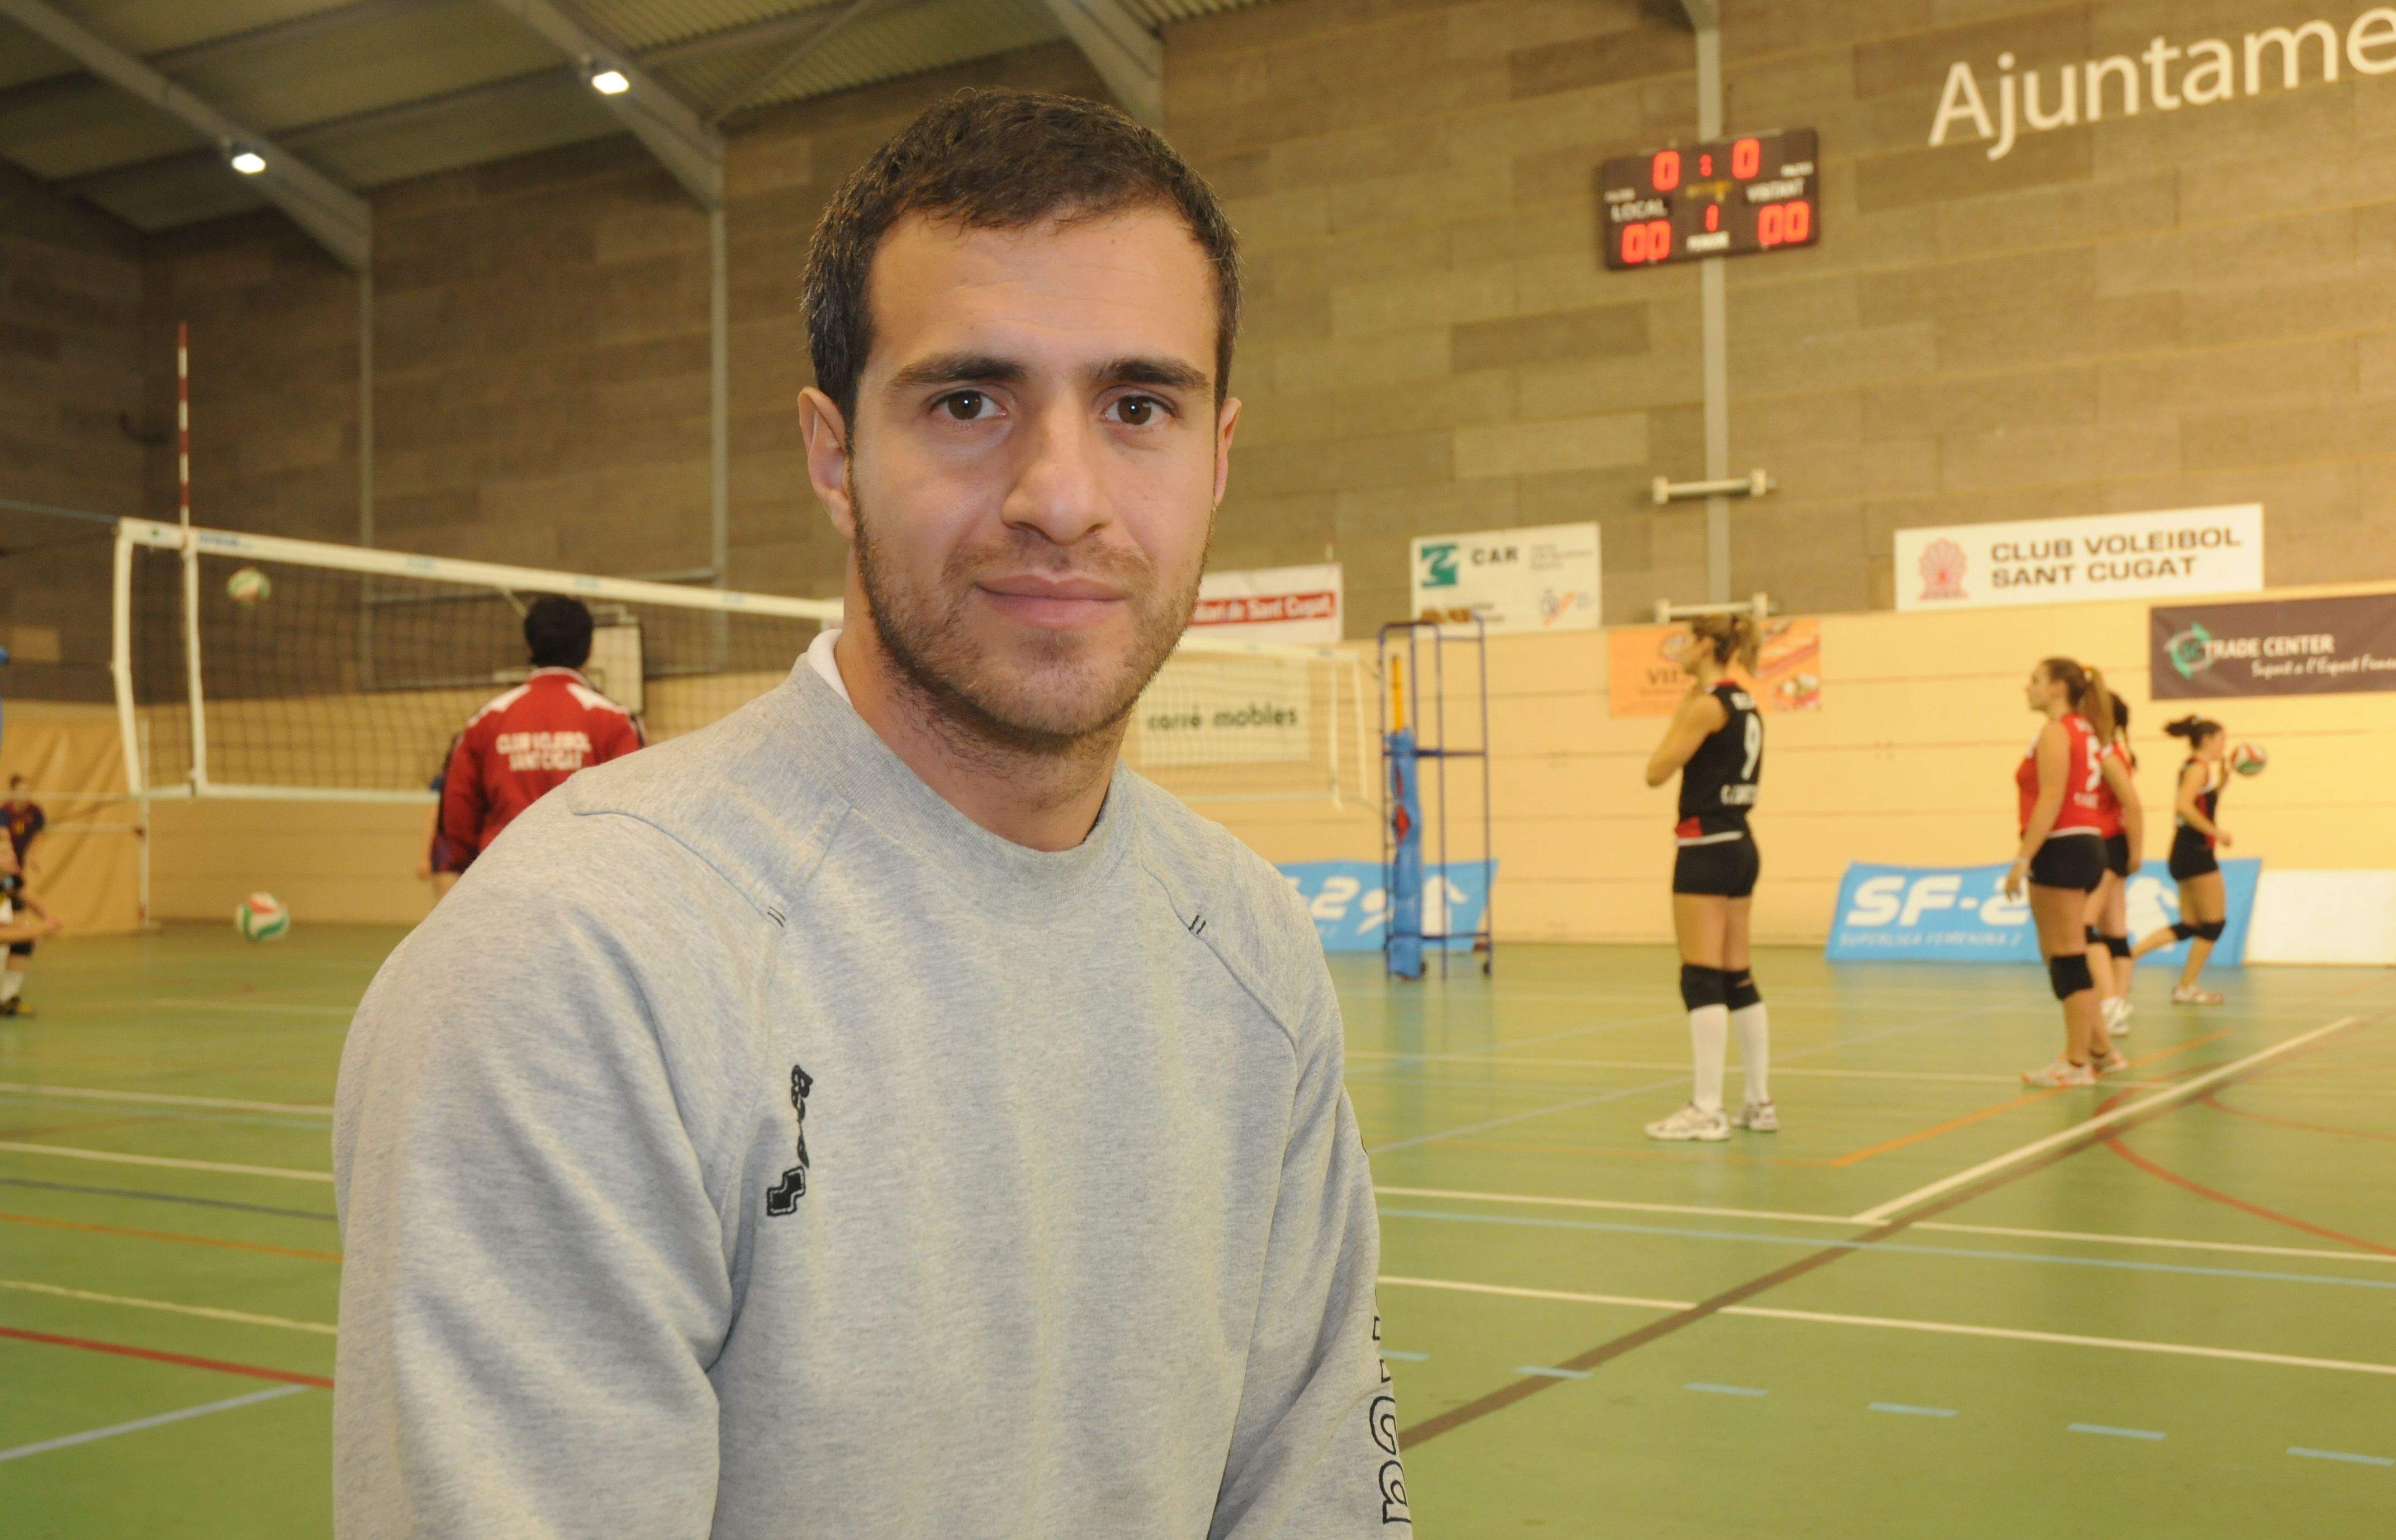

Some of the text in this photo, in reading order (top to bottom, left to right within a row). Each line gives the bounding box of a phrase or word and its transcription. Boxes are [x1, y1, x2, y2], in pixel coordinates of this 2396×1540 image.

[1929, 7, 2396, 161] Ajuntame
[1652, 150, 1680, 191] 0
[1733, 137, 1760, 179] 0
[1610, 198, 1668, 223] LOCAL
[1706, 205, 1719, 231] 1
[1758, 201, 1810, 245] 00
[1622, 220, 1671, 264] 00
[1991, 527, 2242, 563] CLUB VOLEIBOL
[1991, 555, 2198, 589] SANT CUGAT
[1249, 597, 1282, 619] Sant
[2204, 639, 2260, 658] TRADE
[2262, 634, 2335, 658] CENTER
[1213, 701, 1298, 727] mobles
